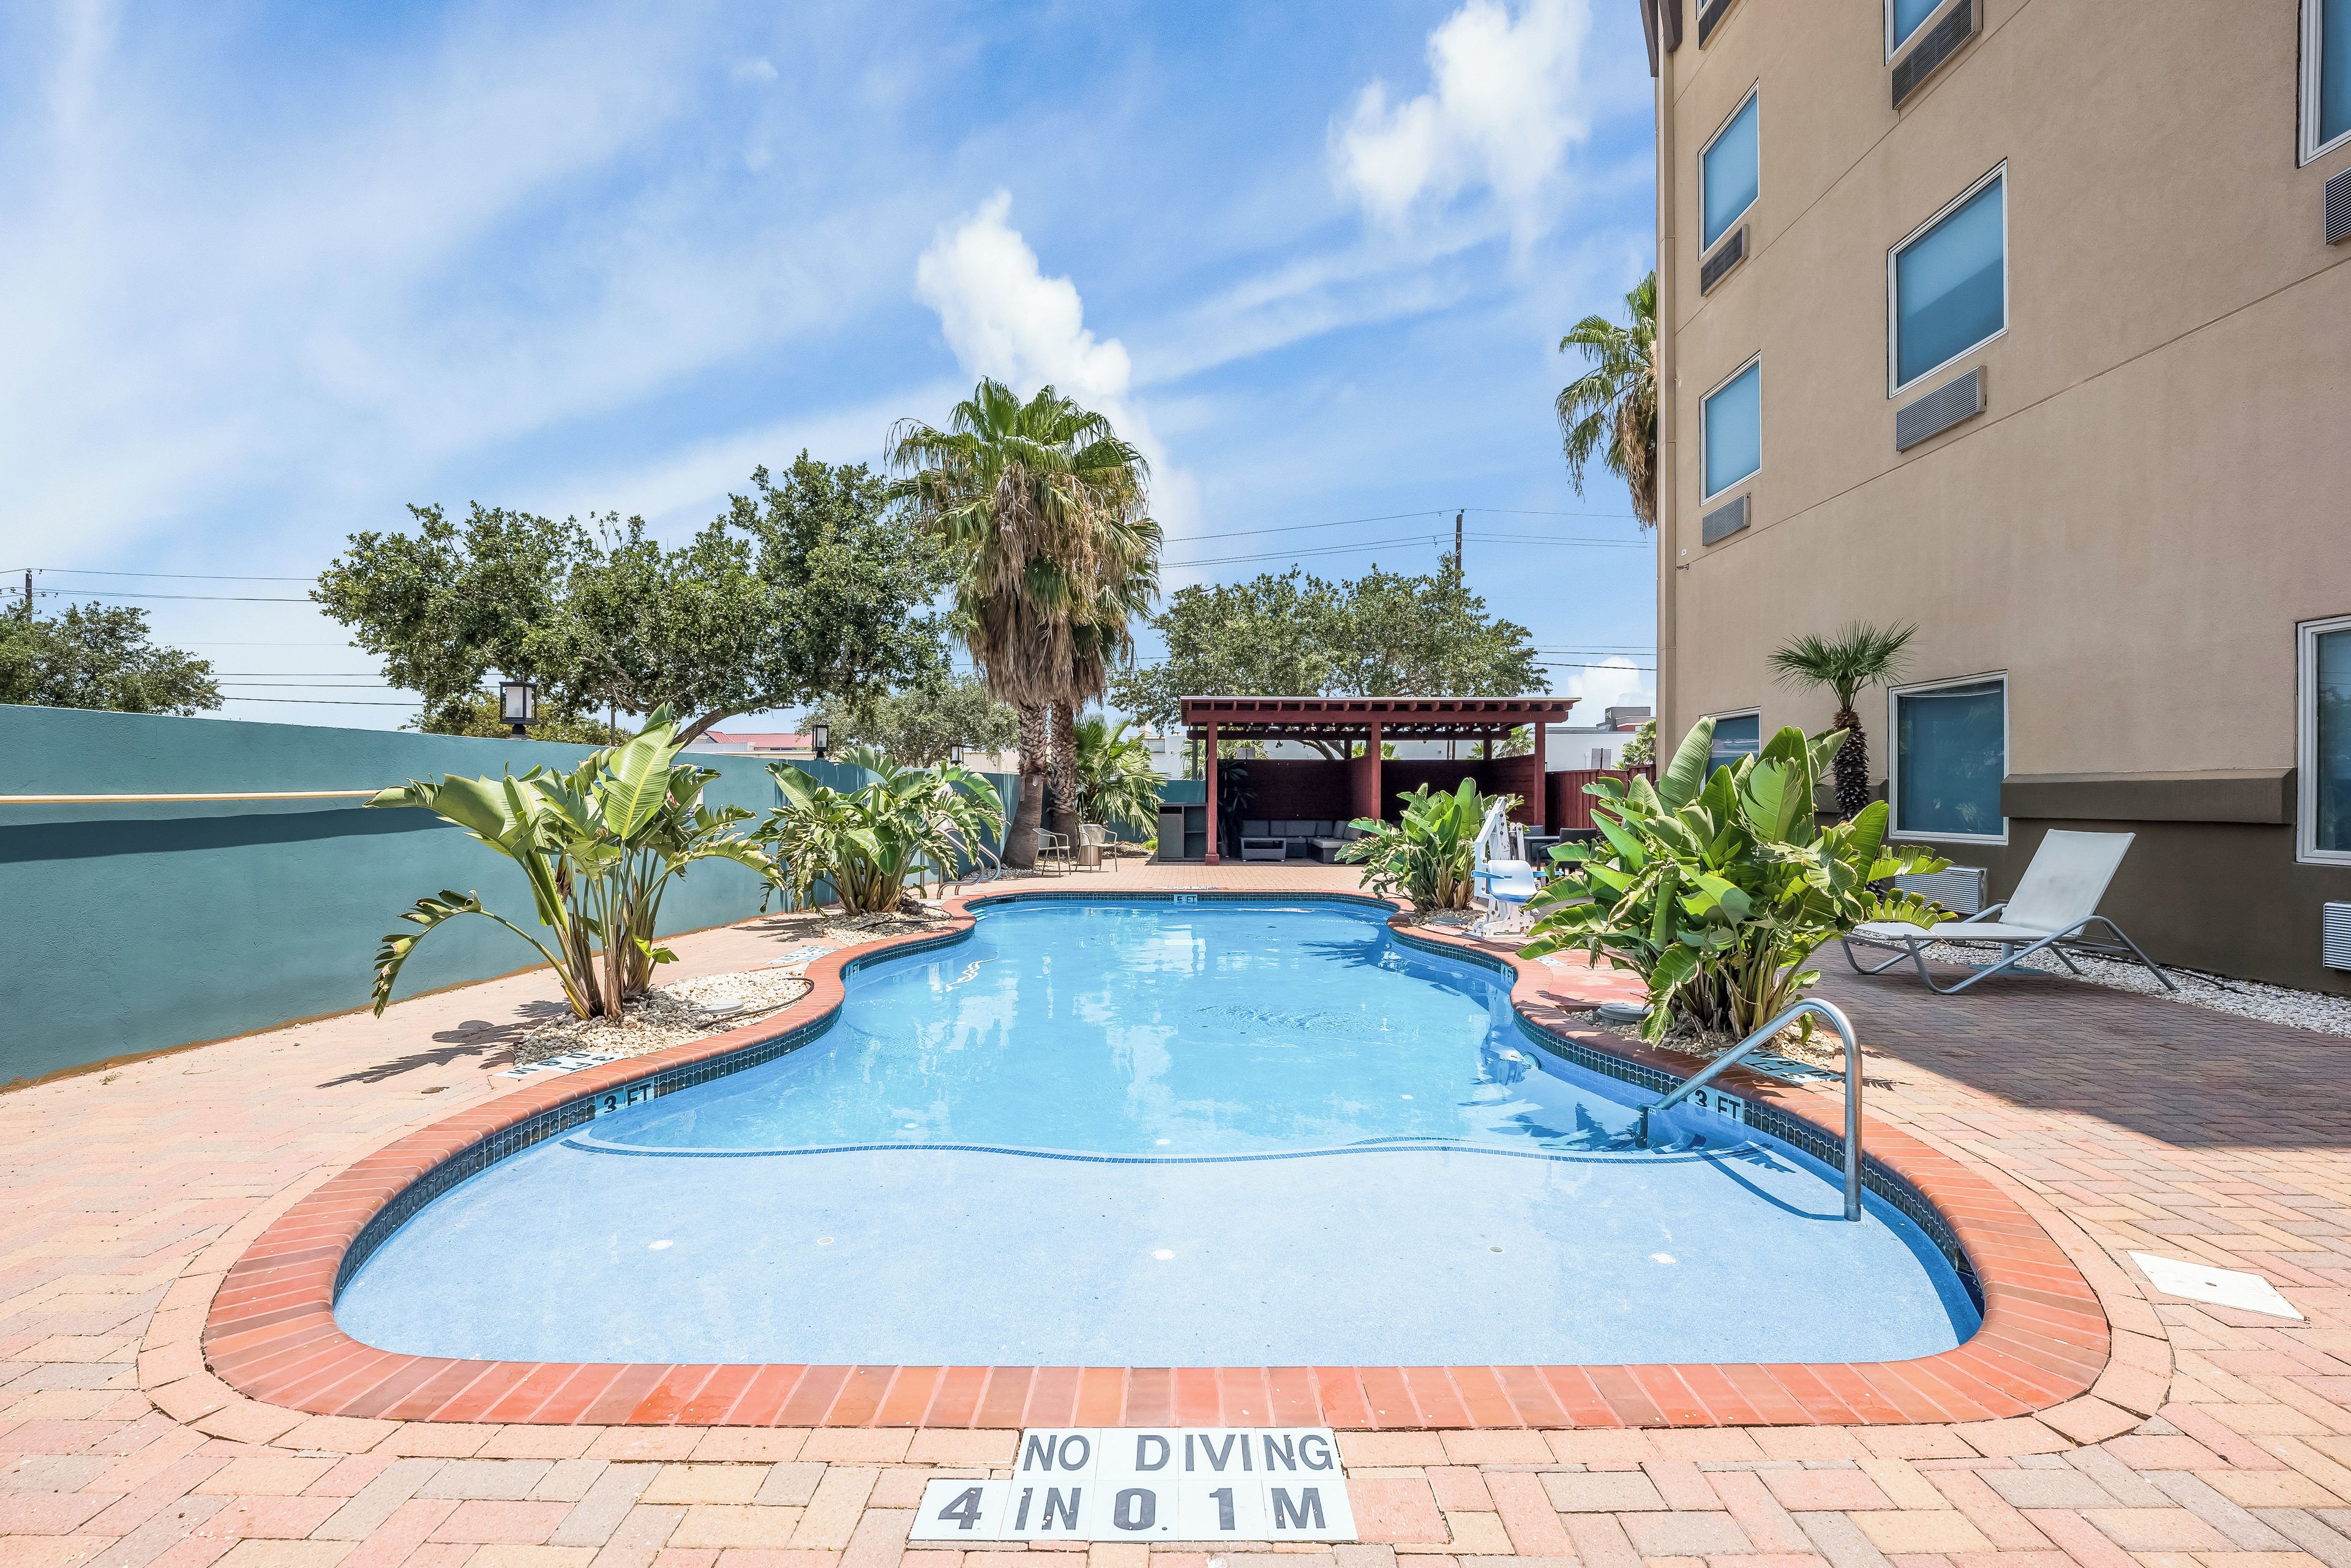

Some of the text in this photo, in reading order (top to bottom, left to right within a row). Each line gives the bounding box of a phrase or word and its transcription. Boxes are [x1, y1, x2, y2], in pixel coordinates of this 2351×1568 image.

[604, 1083, 651, 1113] 3 FT
[1695, 1089, 1741, 1119] 3 FT
[1023, 1434, 1335, 1472] NO DIVING
[937, 1487, 982, 1530] 4
[1016, 1487, 1081, 1531] IN
[1270, 1487, 1326, 1529] M
